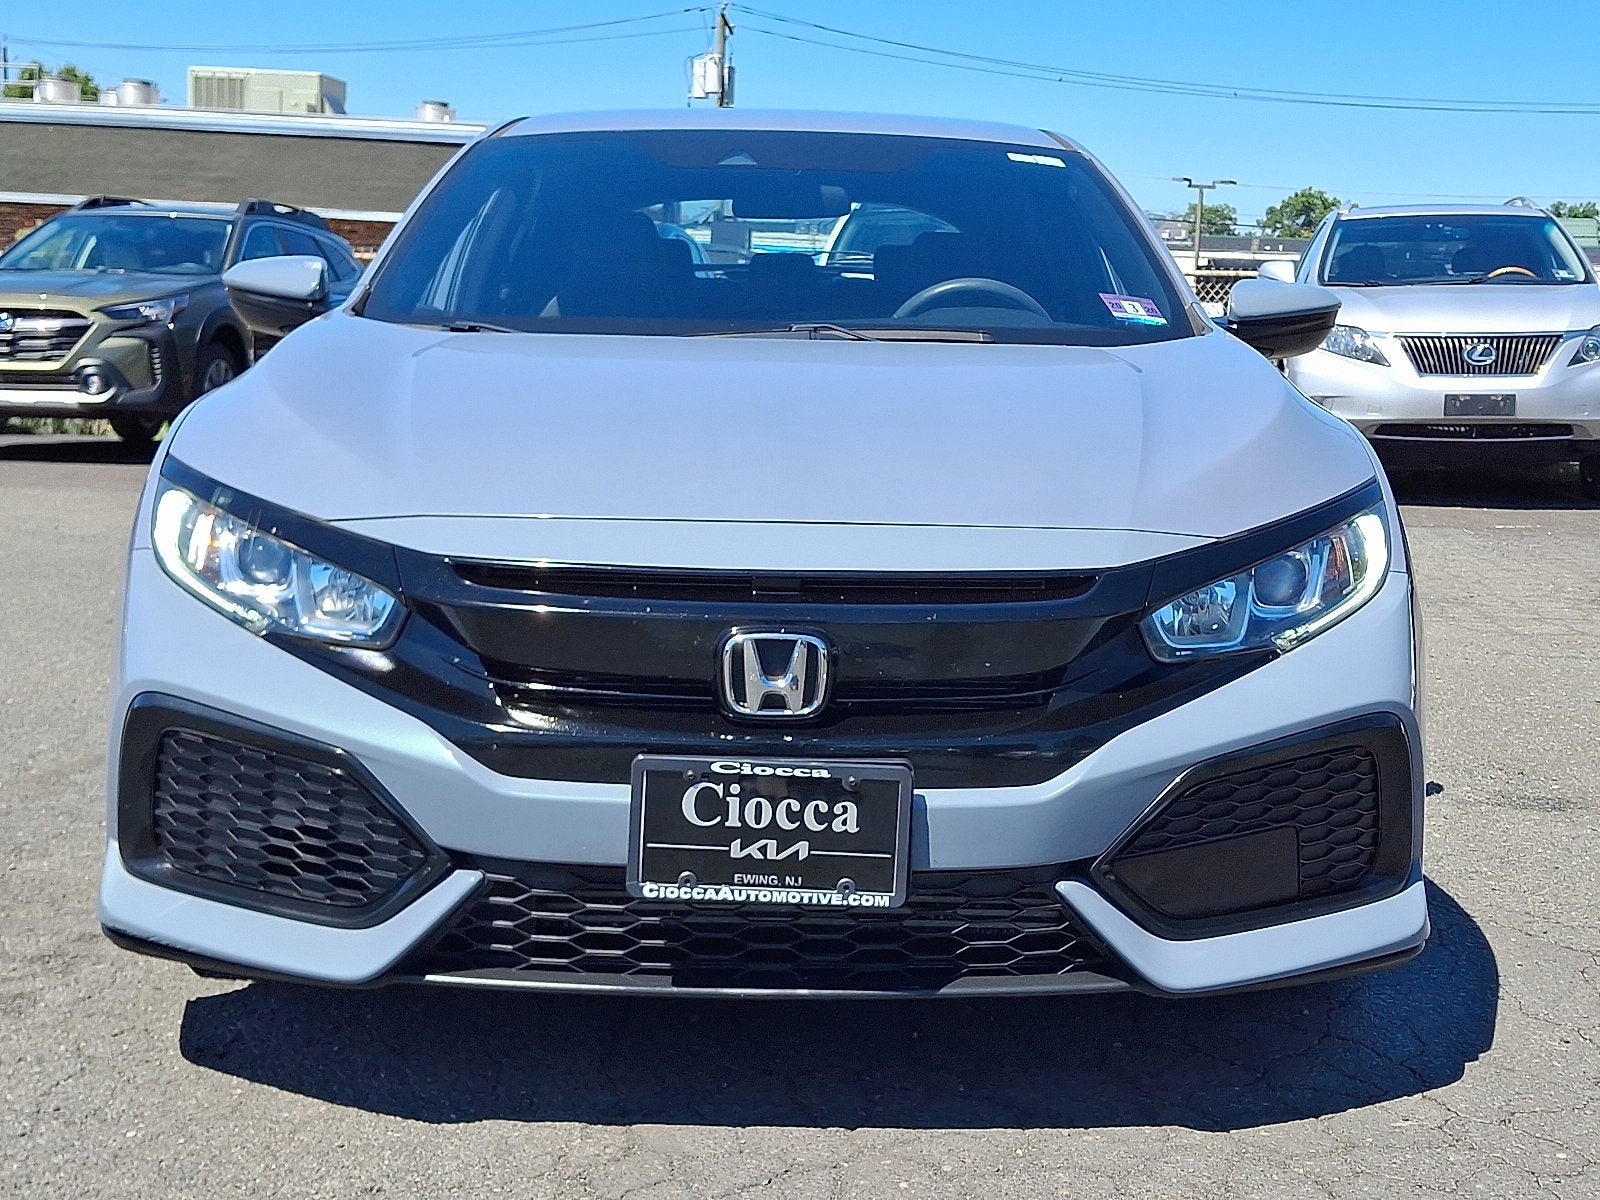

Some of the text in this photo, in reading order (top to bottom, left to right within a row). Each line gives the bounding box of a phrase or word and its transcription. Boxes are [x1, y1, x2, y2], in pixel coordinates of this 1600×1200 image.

[710, 761, 831, 779] Ciocca
[681, 782, 860, 834] Ciocca
[730, 838, 809, 862] KIA
[785, 875, 802, 887] NJ
